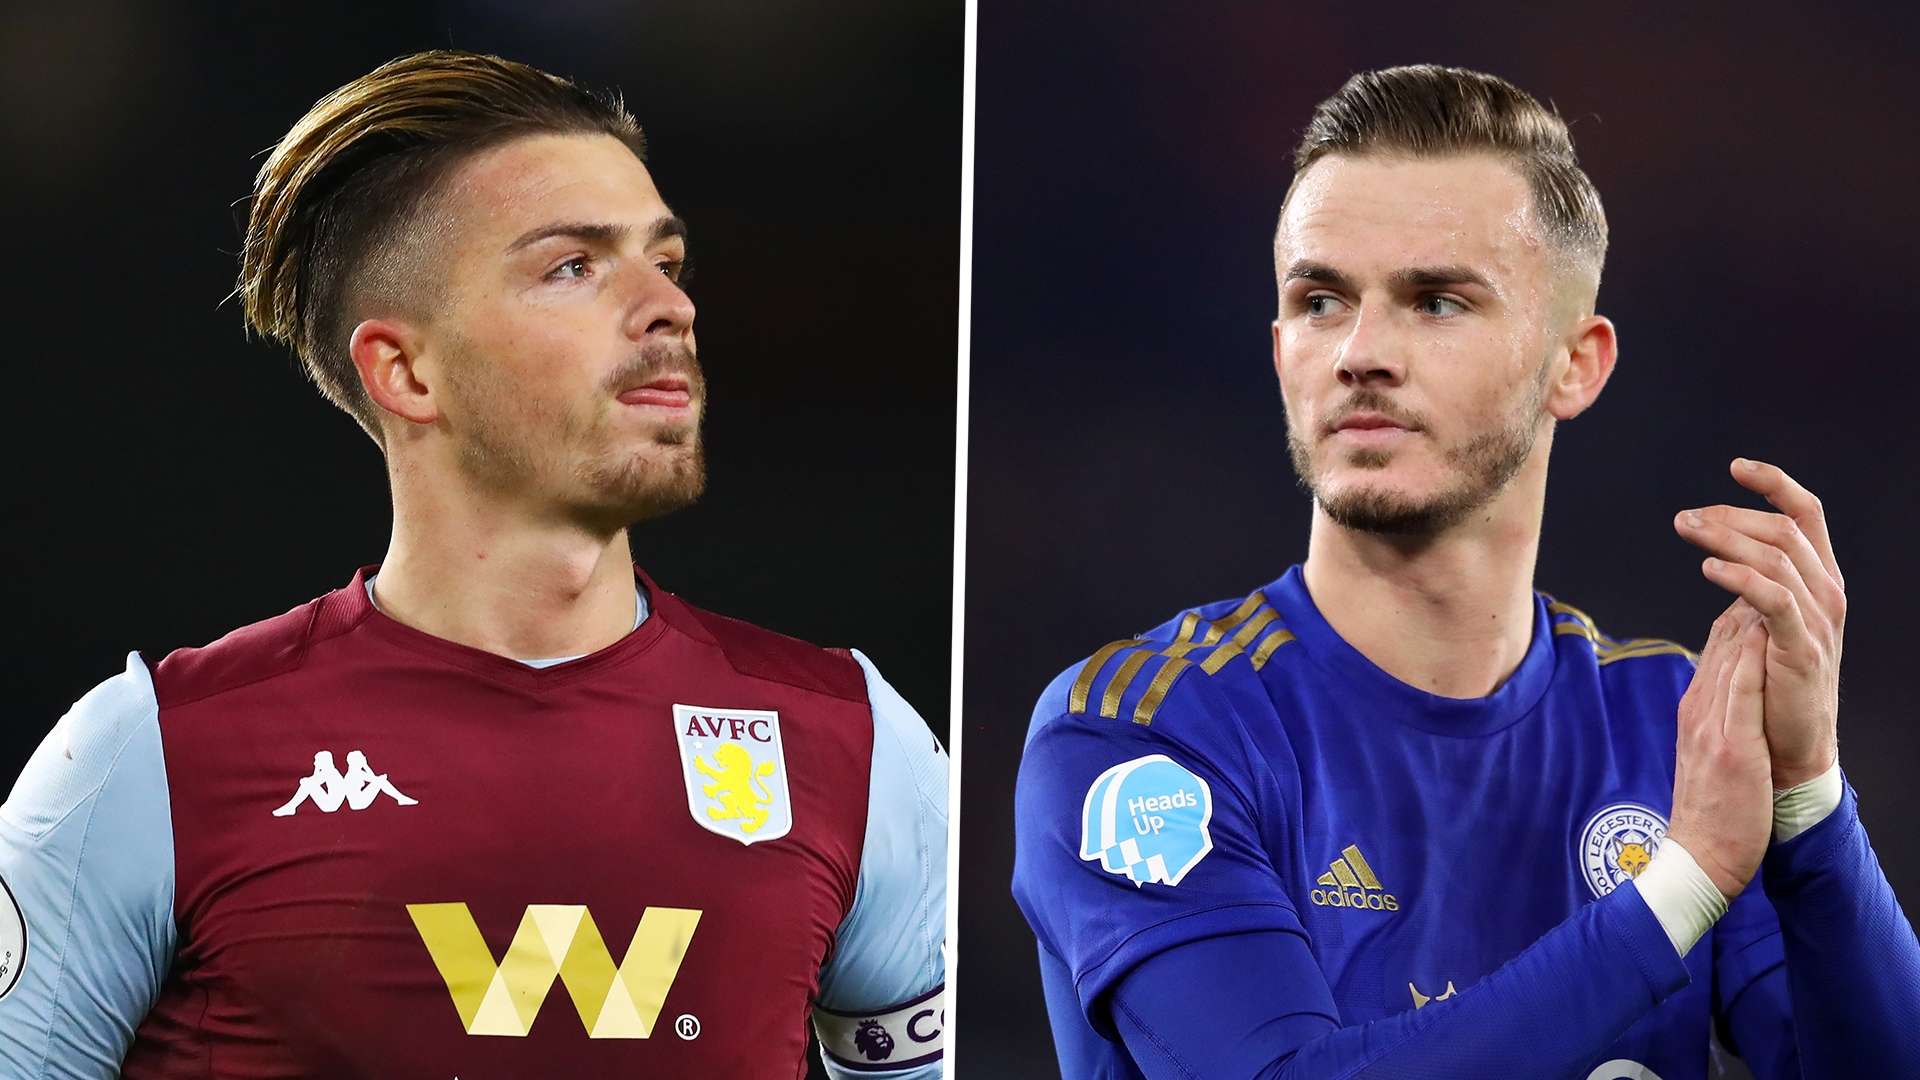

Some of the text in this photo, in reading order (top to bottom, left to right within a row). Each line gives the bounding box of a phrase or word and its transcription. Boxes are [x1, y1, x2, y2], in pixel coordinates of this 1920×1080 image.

[685, 714, 772, 743] AVFC
[1127, 788, 1198, 818] Heads
[1133, 813, 1165, 836] Up
[1590, 814, 1654, 858] LEICESTER
[1310, 885, 1400, 912] adidas
[405, 901, 704, 1040] W
[906, 1008, 946, 1044] C
